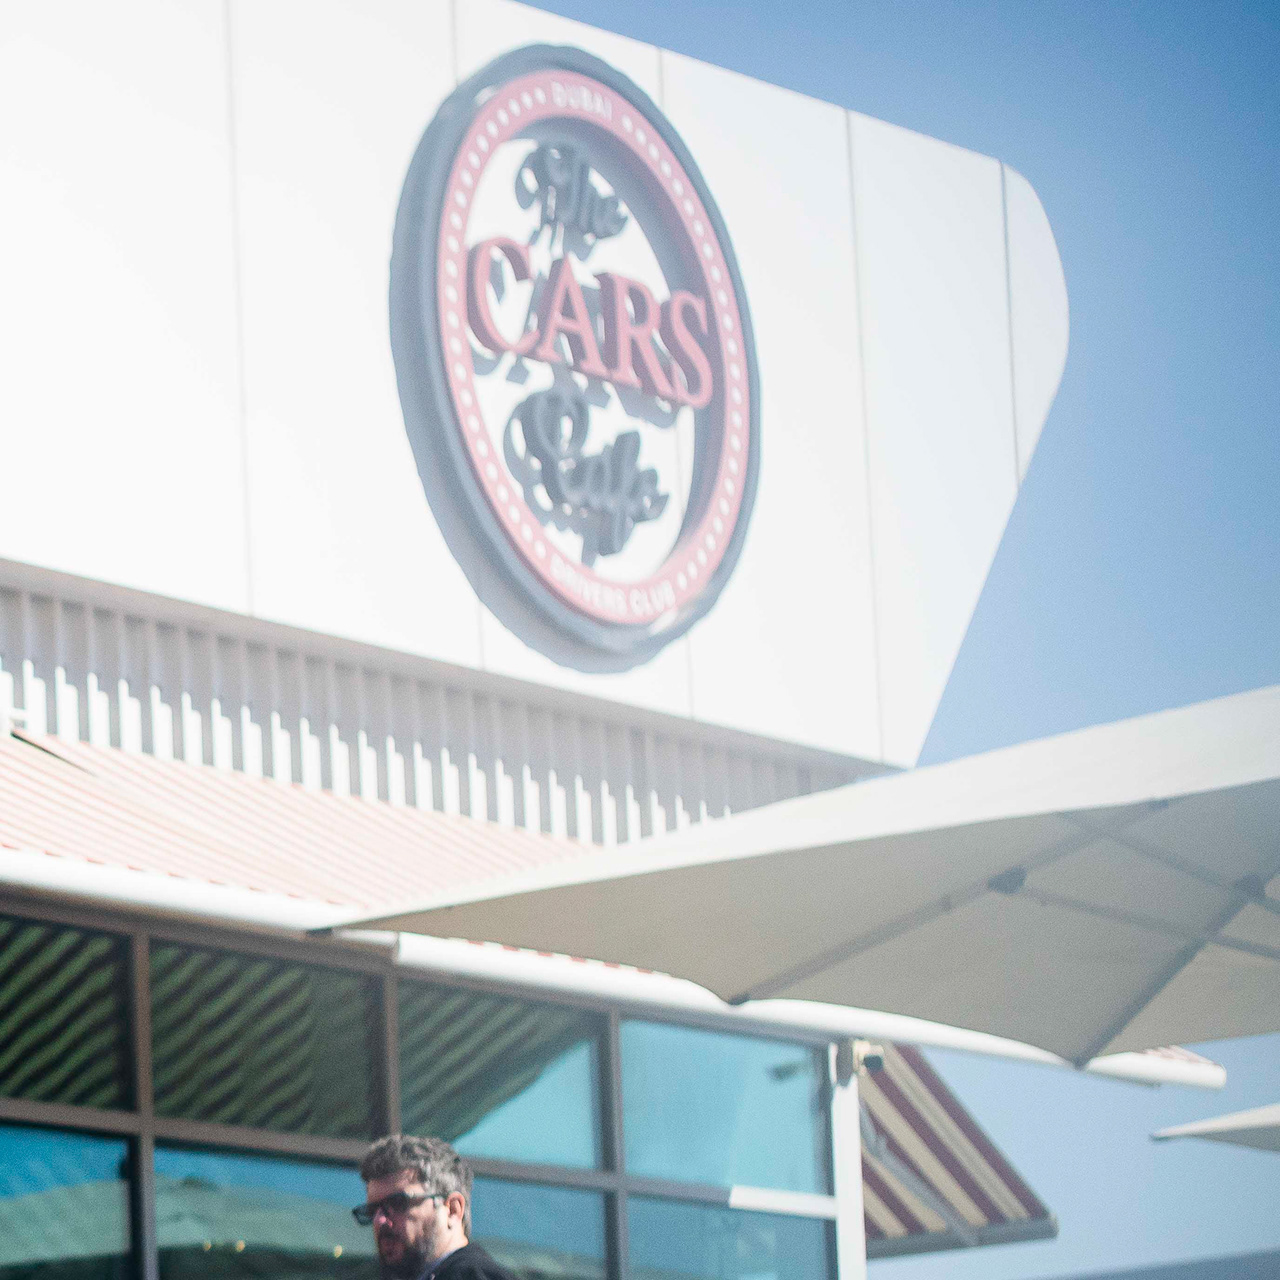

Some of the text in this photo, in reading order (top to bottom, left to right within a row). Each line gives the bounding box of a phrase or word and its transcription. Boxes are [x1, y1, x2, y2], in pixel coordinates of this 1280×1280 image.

[549, 80, 614, 121] DUBAI
[468, 237, 713, 409] CARS
[549, 552, 676, 617] DRIVERS CLUB
